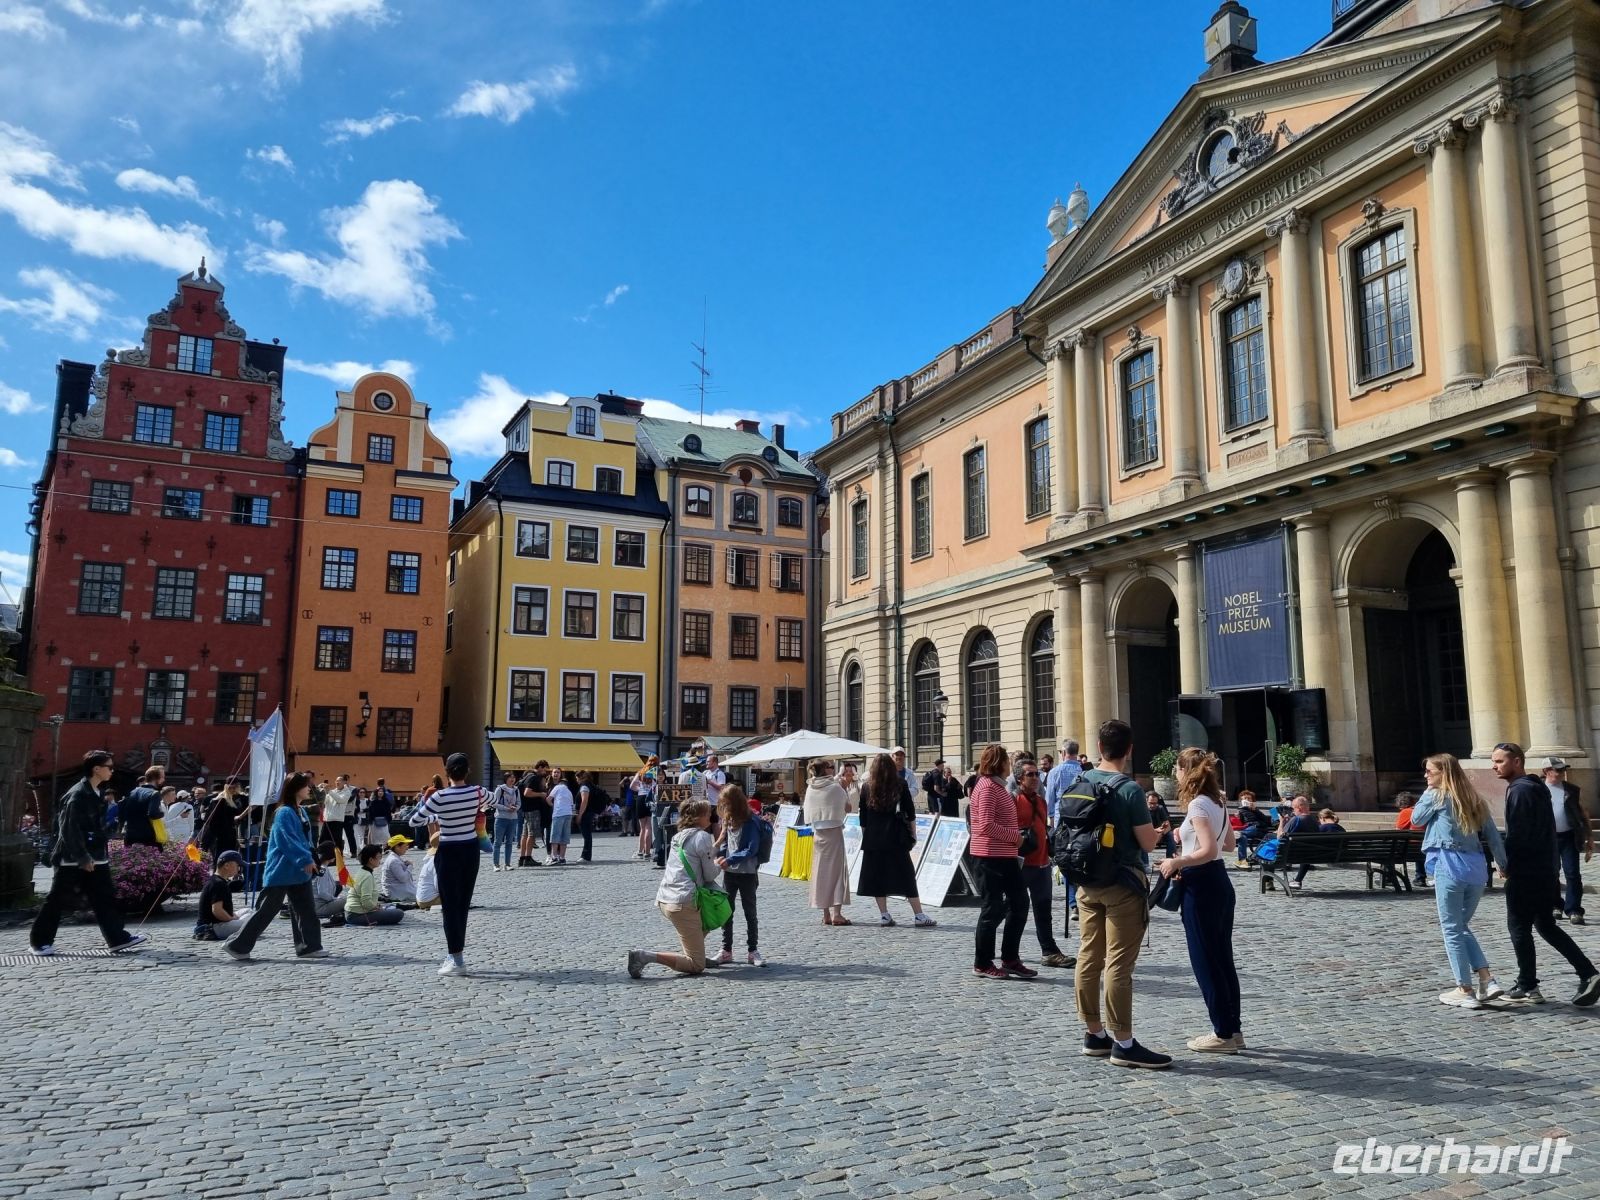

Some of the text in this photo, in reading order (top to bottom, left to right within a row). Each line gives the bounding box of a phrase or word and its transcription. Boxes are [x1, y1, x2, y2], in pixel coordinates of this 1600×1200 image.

[1140, 159, 1326, 281] SVENSKA AKADEMIEN
[1224, 591, 1262, 607] NOBEL
[1228, 605, 1259, 620] PRIZE
[1219, 617, 1271, 635] MUSEUM
[659, 790, 691, 801] ART
